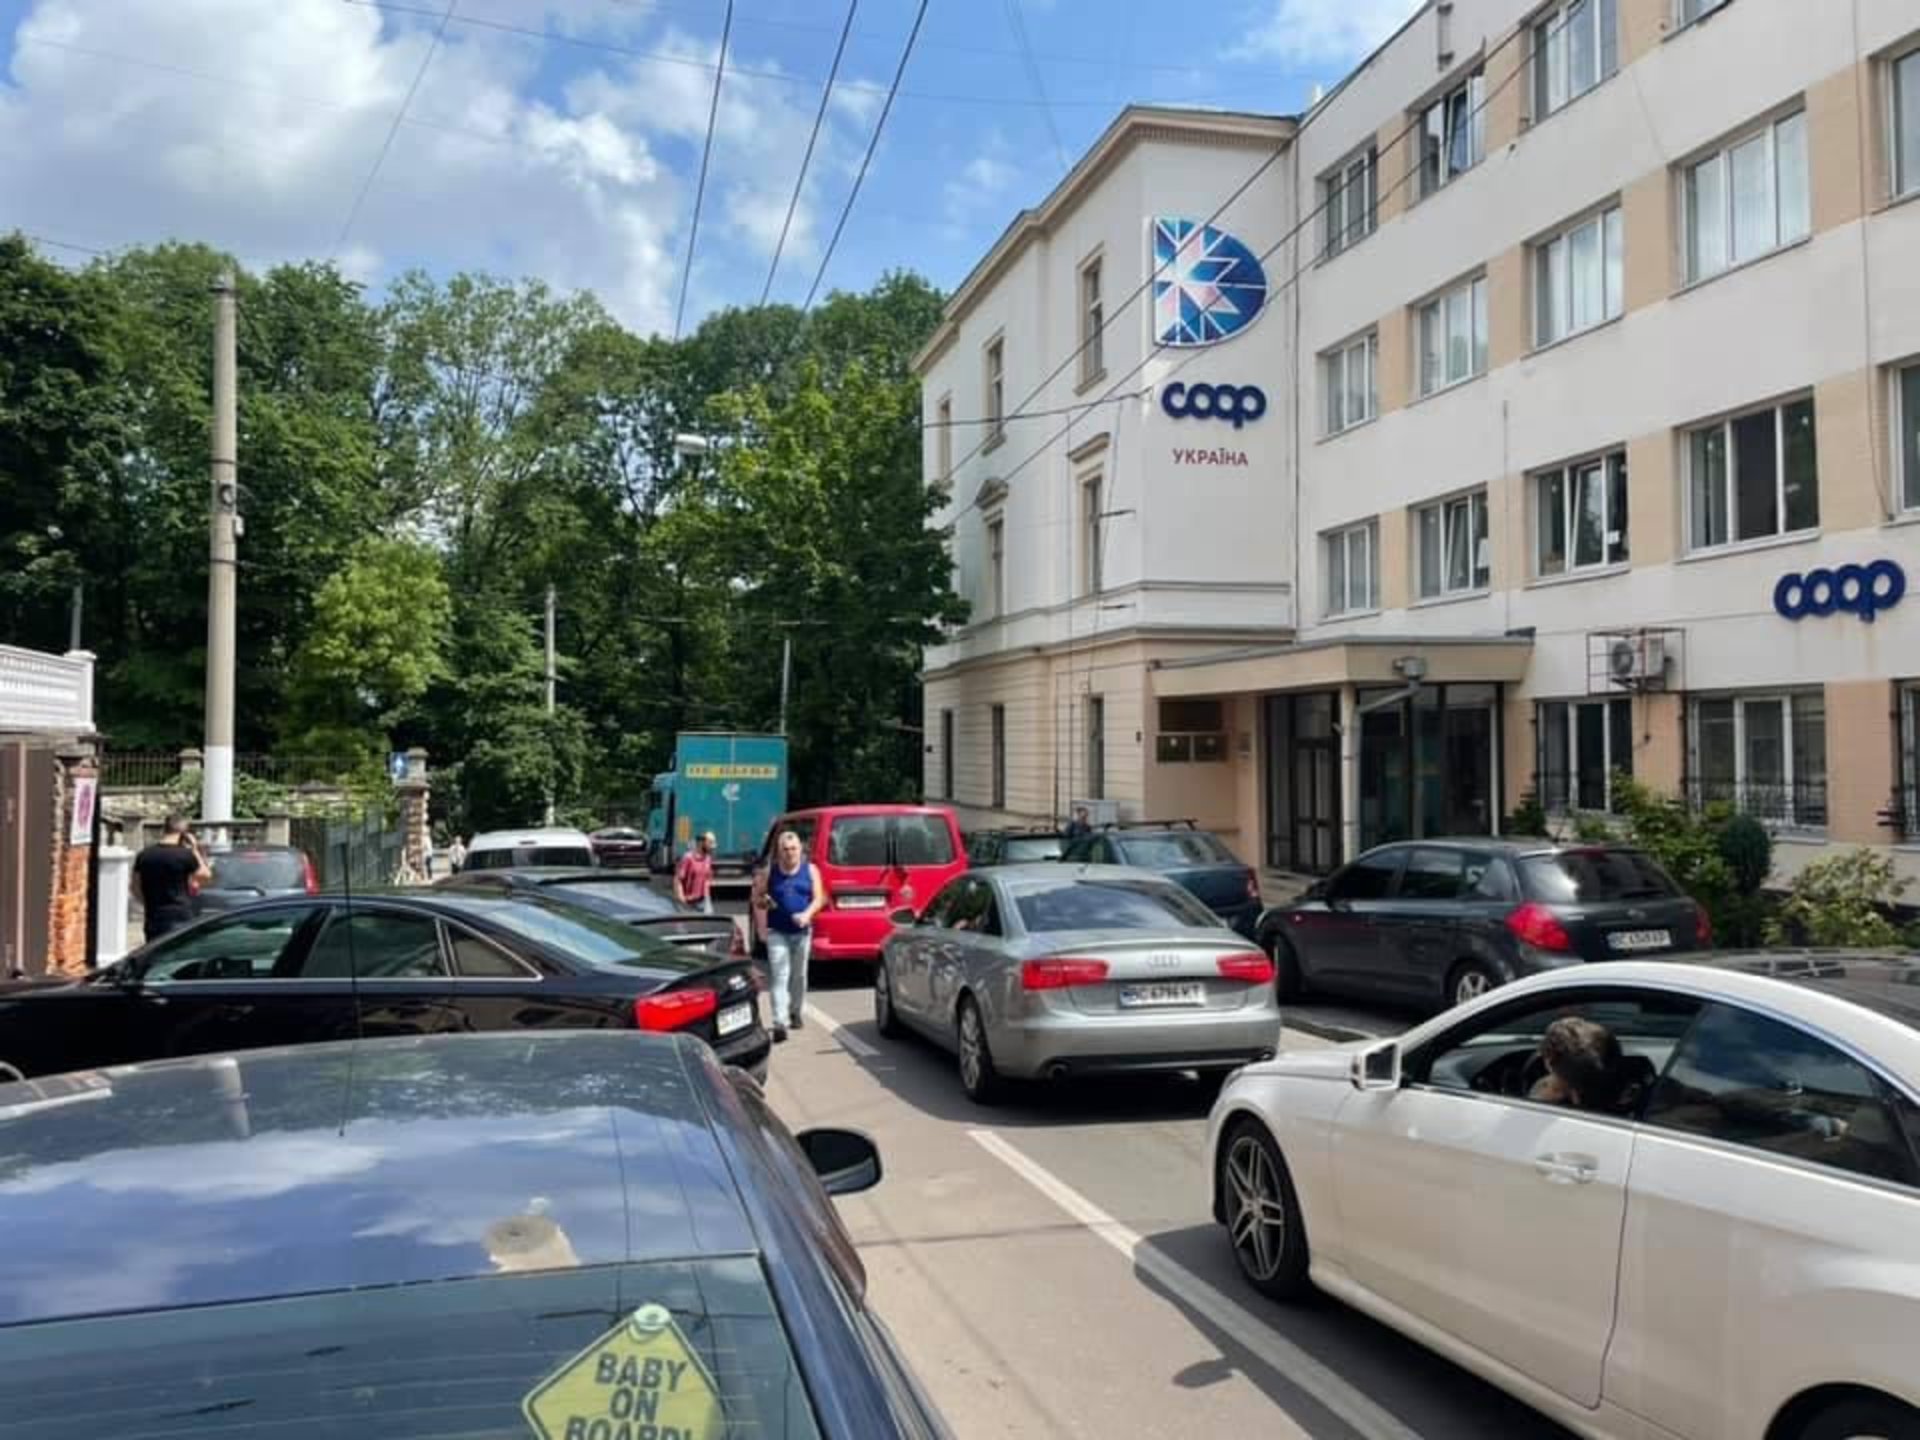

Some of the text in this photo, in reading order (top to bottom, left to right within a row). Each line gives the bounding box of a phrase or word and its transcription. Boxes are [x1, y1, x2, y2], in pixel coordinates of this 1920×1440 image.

[1172, 447, 1249, 466] УКРАЇНА
[594, 1351, 688, 1392] BABY
[611, 1387, 659, 1422] ON
